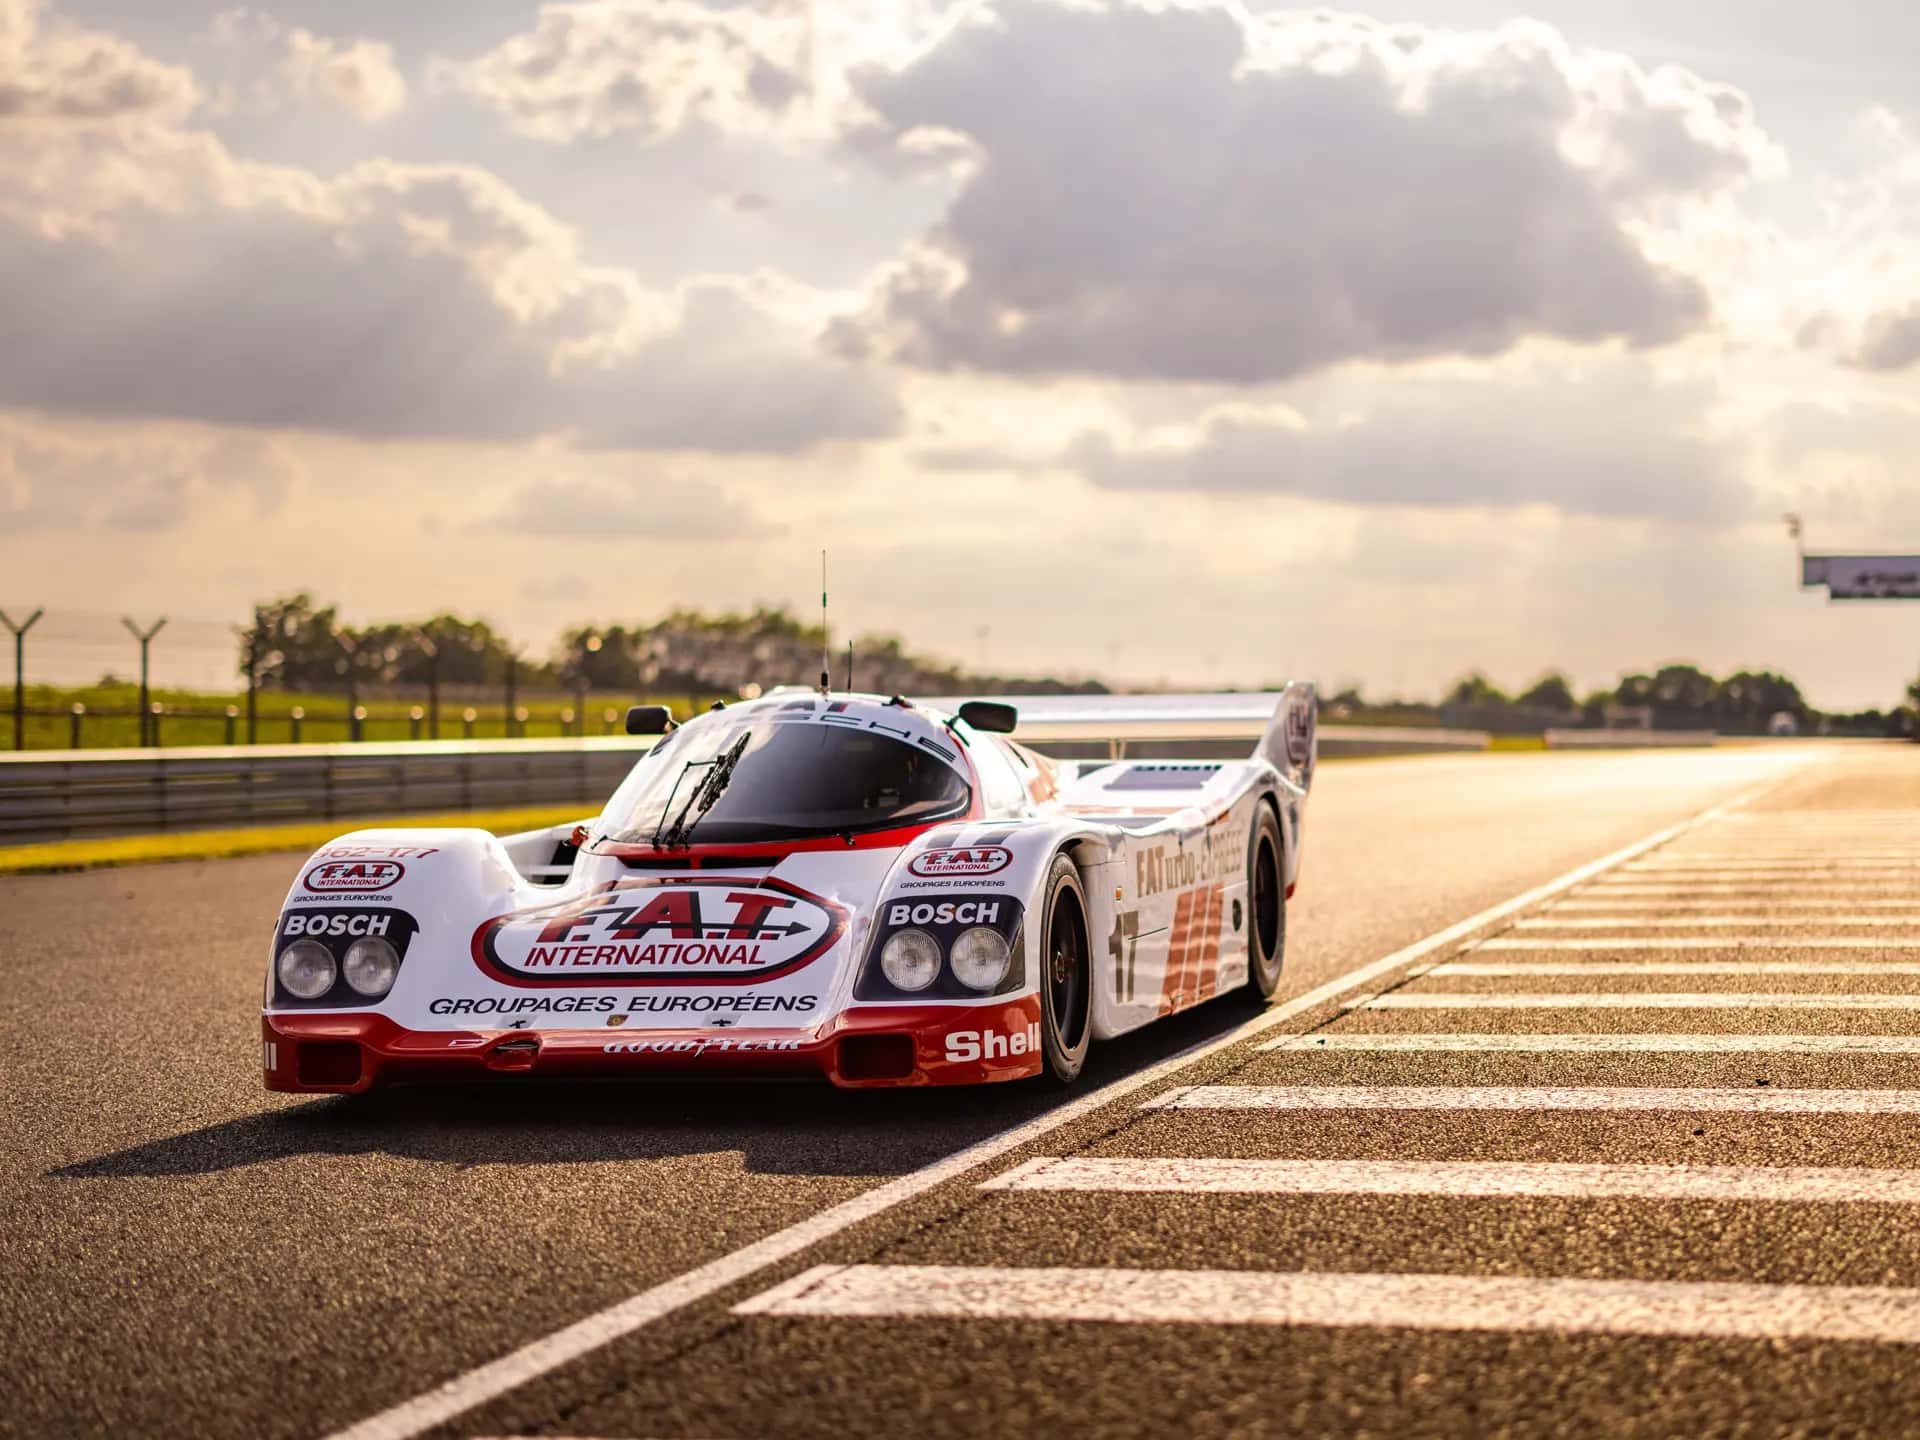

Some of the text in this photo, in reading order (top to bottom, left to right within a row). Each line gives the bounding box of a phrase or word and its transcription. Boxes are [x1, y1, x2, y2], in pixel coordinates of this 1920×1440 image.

[900, 881, 951, 889] GROUPAGES
[284, 914, 391, 935] BOSCH
[888, 902, 1000, 925] BOSCH
[524, 943, 767, 966] INTERNATIONAL
[1108, 910, 1139, 1004] 17
[429, 992, 818, 1014] GROUPAGES EUROPÉENS
[945, 1022, 1041, 1063] Shell
